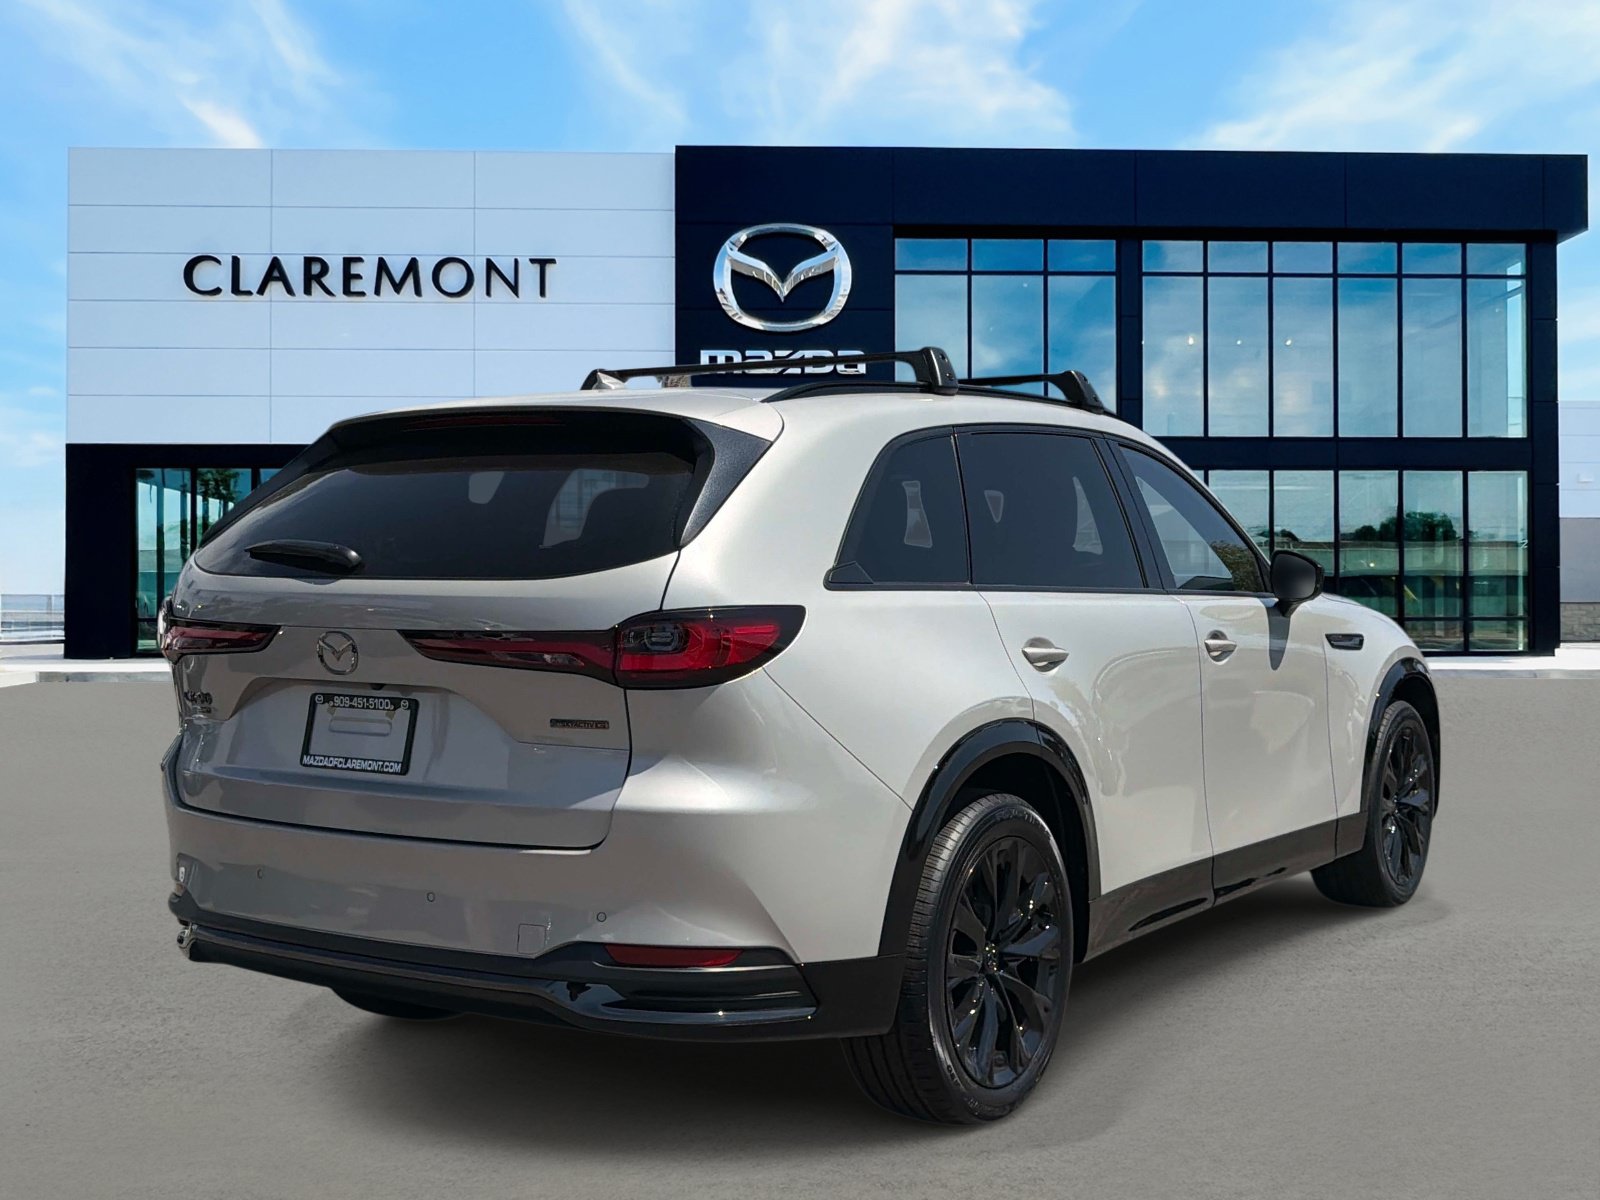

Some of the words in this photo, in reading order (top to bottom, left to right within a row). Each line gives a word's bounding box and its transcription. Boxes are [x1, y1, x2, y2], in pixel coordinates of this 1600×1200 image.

[183, 254, 557, 299] CLAREMONT
[333, 695, 391, 710] 909-451-5100
[302, 755, 402, 774] MAZDAOFCLAREMONT.COM
